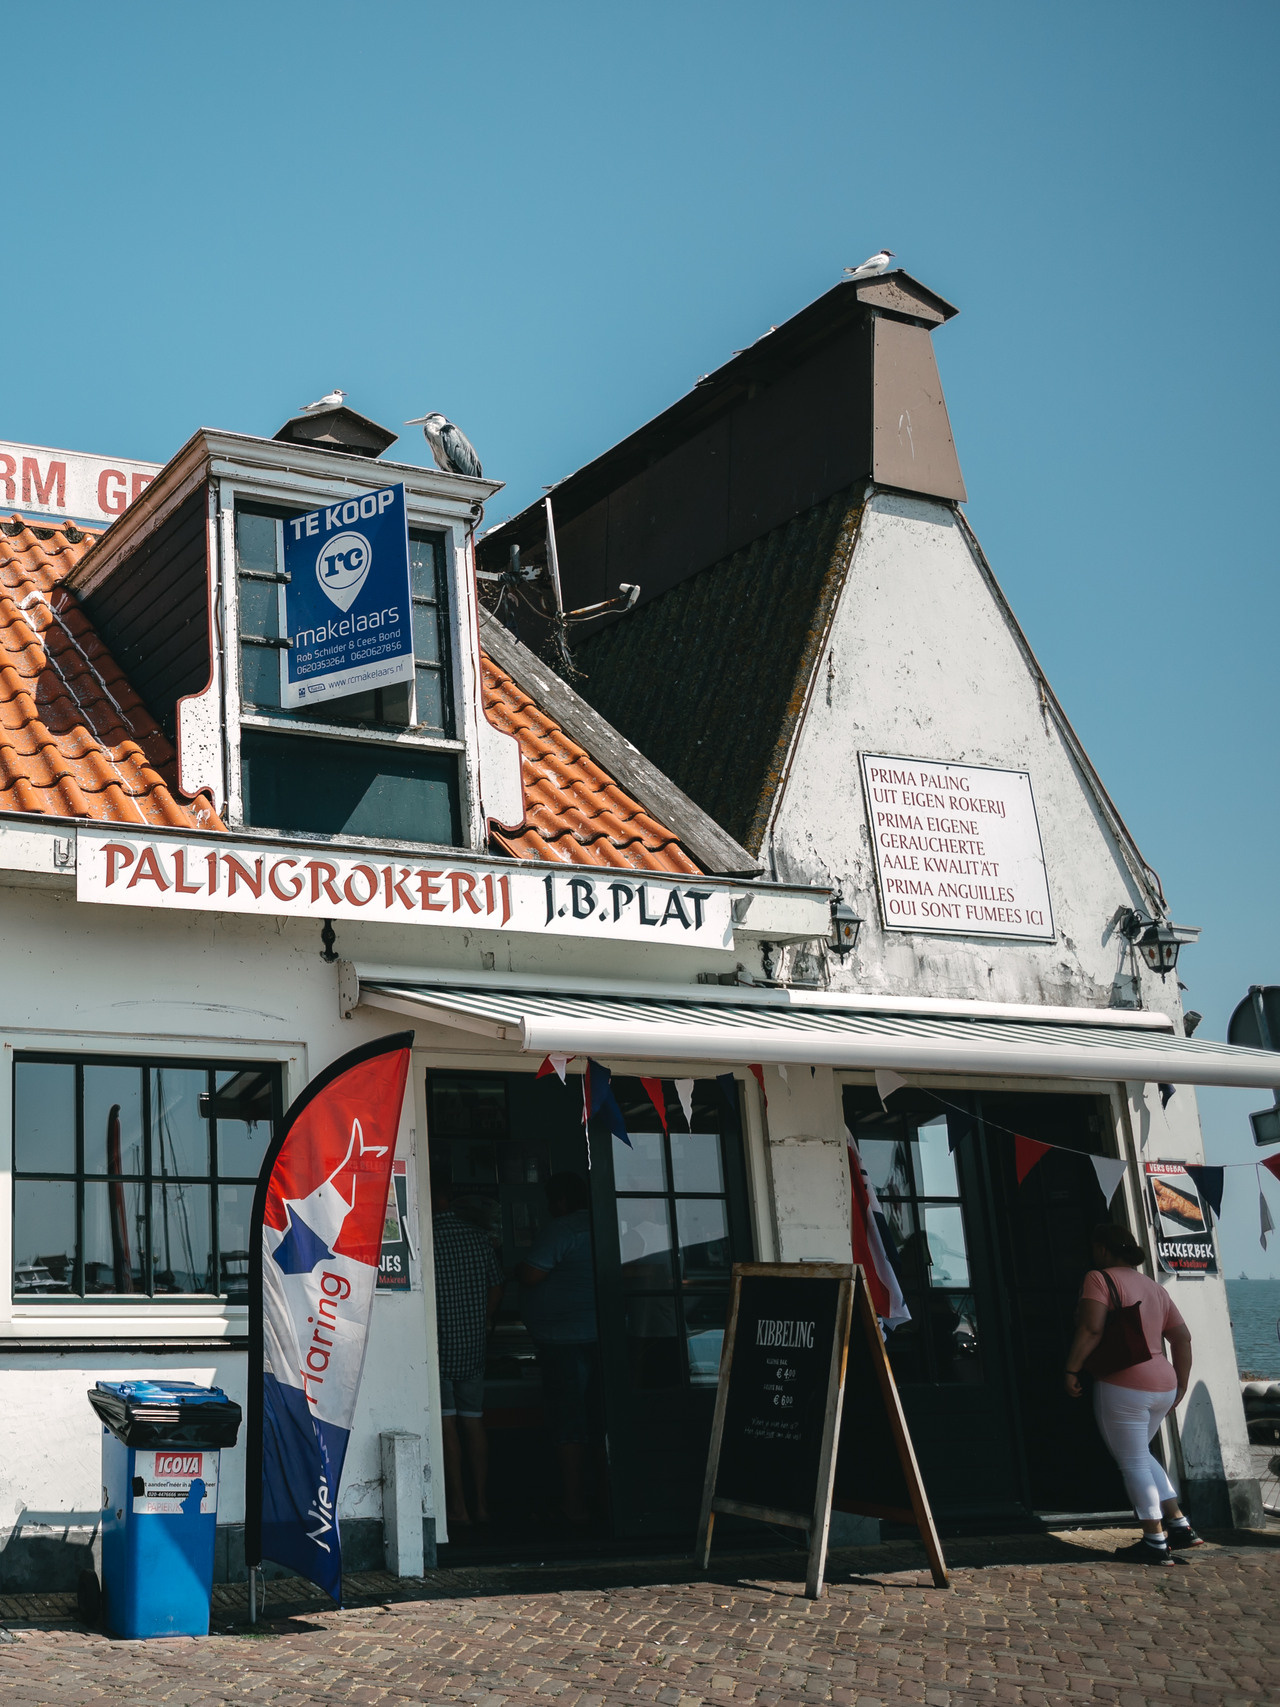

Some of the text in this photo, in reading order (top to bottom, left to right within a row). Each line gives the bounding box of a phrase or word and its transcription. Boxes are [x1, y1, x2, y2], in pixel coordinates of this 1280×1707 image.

[290, 489, 395, 541] TE KOOP
[324, 547, 364, 579] rc
[296, 606, 400, 649] makelaars
[296, 641, 402, 675] 0620353264 0620627856
[297, 652, 313, 664] Rob
[314, 643, 347, 660] Schilder
[356, 636, 377, 648] Cees
[378, 629, 401, 644] Bond
[328, 663, 404, 690] www.rcmakelaars.nl
[870, 767, 970, 792] PRIMA PALING
[873, 787, 1006, 819] UIT EIGEN ROKERIJ
[876, 811, 979, 836] PRIMA EIGENE
[880, 832, 986, 856] GERAUCHERTE
[883, 853, 920, 871] AALE
[99, 839, 713, 931] PALINGROKERIJ J.B.PLAT
[886, 878, 1015, 903] PRIMA ANGUILLES
[889, 899, 1044, 926] OUI SONT FUMEES ICI
[378, 1255, 402, 1272] JES
[1158, 1242, 1214, 1258] LEKKERBEK
[756, 1319, 815, 1348] KIBBELING
[158, 1456, 200, 1474] ICOVA
